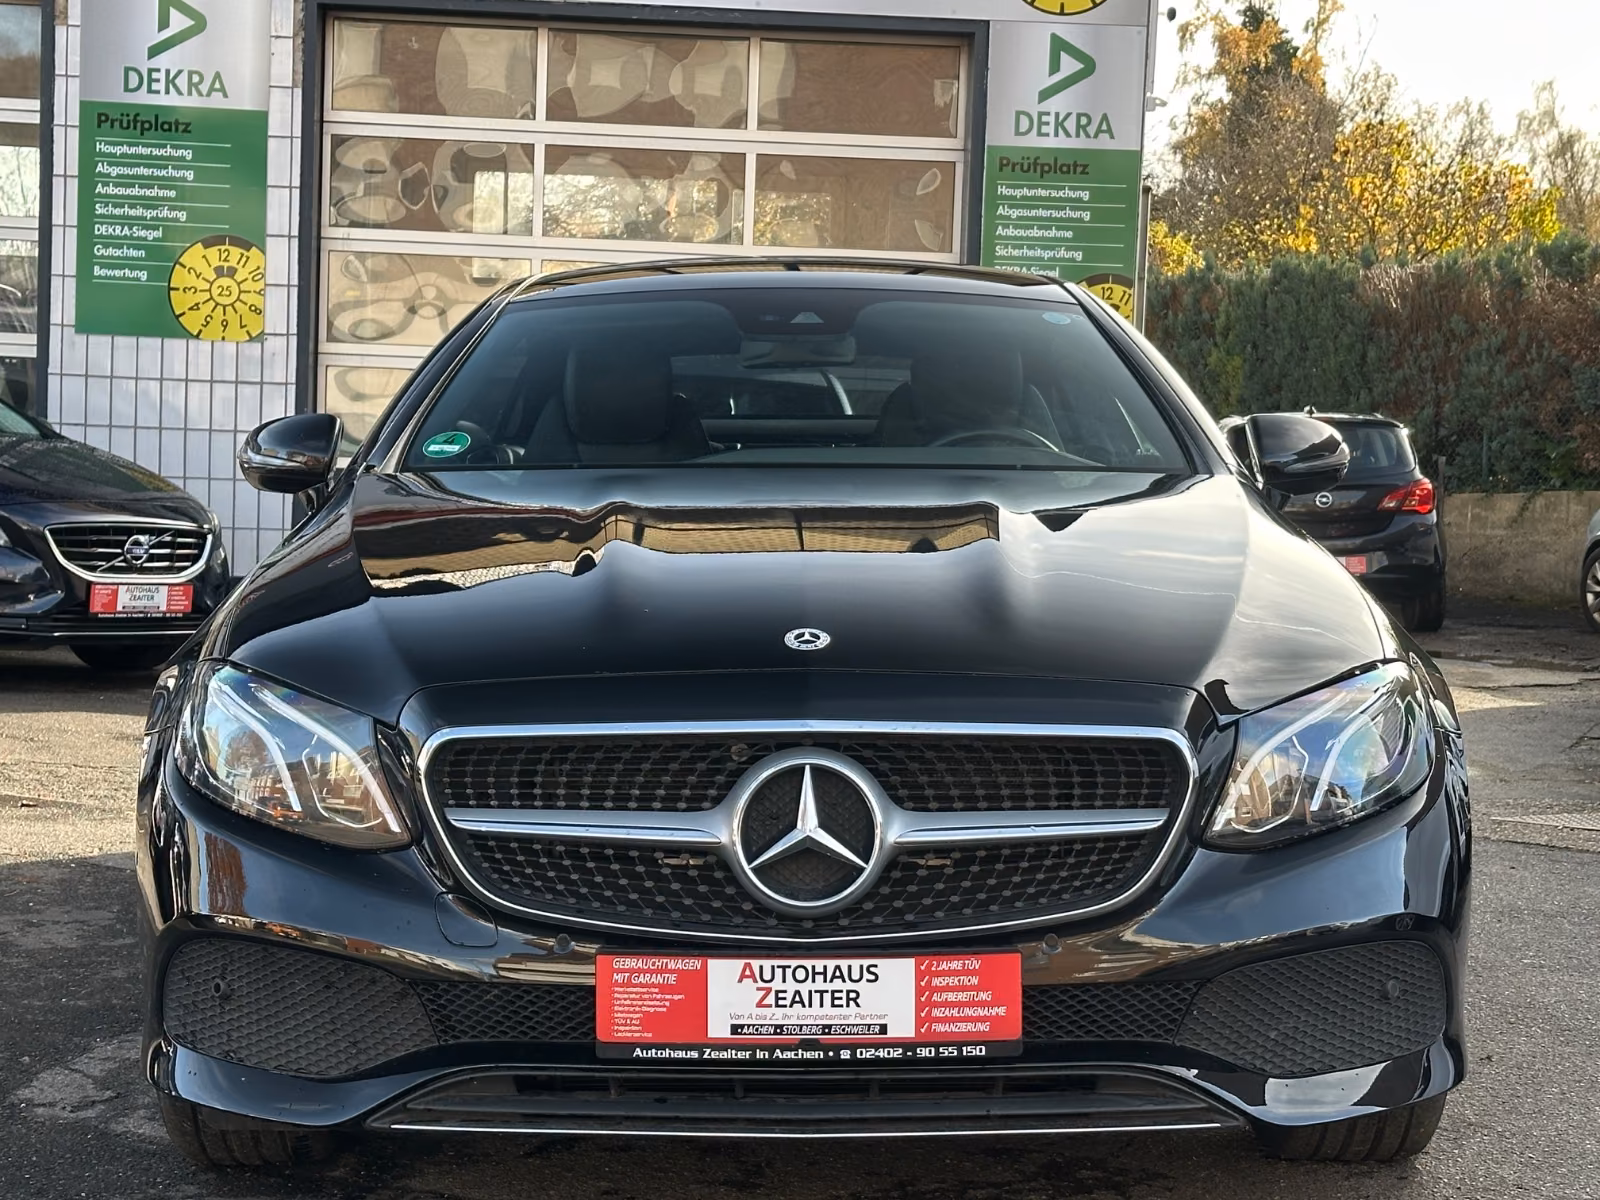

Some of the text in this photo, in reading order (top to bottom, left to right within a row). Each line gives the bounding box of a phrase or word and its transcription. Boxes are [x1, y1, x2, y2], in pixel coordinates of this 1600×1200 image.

[123, 66, 229, 99] DEKRA
[96, 112, 192, 136] Prüfplatz
[1014, 110, 1115, 140] DEKRA
[96, 142, 193, 160] Hauptuntersuchung
[95, 163, 194, 180] Abgasuntersuchung
[998, 156, 1090, 179] Prüfplatz
[95, 183, 176, 198] Anbauabnahme
[997, 185, 1090, 201] Hauptuntersuchung
[94, 204, 187, 222] Sicherheitsprüfung
[996, 205, 1090, 221] Abgasuntersuchung
[94, 225, 162, 240] DEKRA-Siegel
[995, 226, 1073, 239] Anbauabnahme
[93, 245, 145, 258] Gutachten
[217, 248, 230, 262] 12
[995, 245, 1083, 260] Sicherheitsprüfung
[202, 254, 212, 268] 1
[236, 252, 250, 268] 11
[93, 266, 148, 281] Bewertung
[187, 266, 202, 279] 2
[248, 265, 264, 282] 10
[182, 286, 198, 295] 3
[216, 284, 232, 297] 25
[1101, 286, 1113, 300] 12
[188, 301, 201, 311] 4
[248, 303, 262, 315] 8
[200, 314, 213, 328] 5
[442, 433, 458, 445] 4
[612, 958, 701, 970] GEBRAUCHTWAGEN
[931, 957, 981, 971] 2 JAHRE TÜV
[612, 973, 678, 984] MIT GARANTIE
[737, 962, 879, 983] AUTOHAUS
[931, 976, 979, 986] INSPEKTION
[755, 986, 861, 1008] ZEAITER
[931, 991, 992, 1002] AUFBEREITUNG
[931, 1006, 1007, 1017] INZAHLUNGNAHME
[741, 1025, 880, 1035] AACHEN STOLBERG ESCHWEILER
[931, 1022, 990, 1033] FINANZIERUNG
[633, 1048, 699, 1059] Autohaus
[773, 1048, 824, 1059] Aachen
[856, 1048, 903, 1058] 02402
[916, 1047, 935, 1057] 90
[938, 1046, 958, 1056] 55
[961, 1045, 986, 1056] 150
